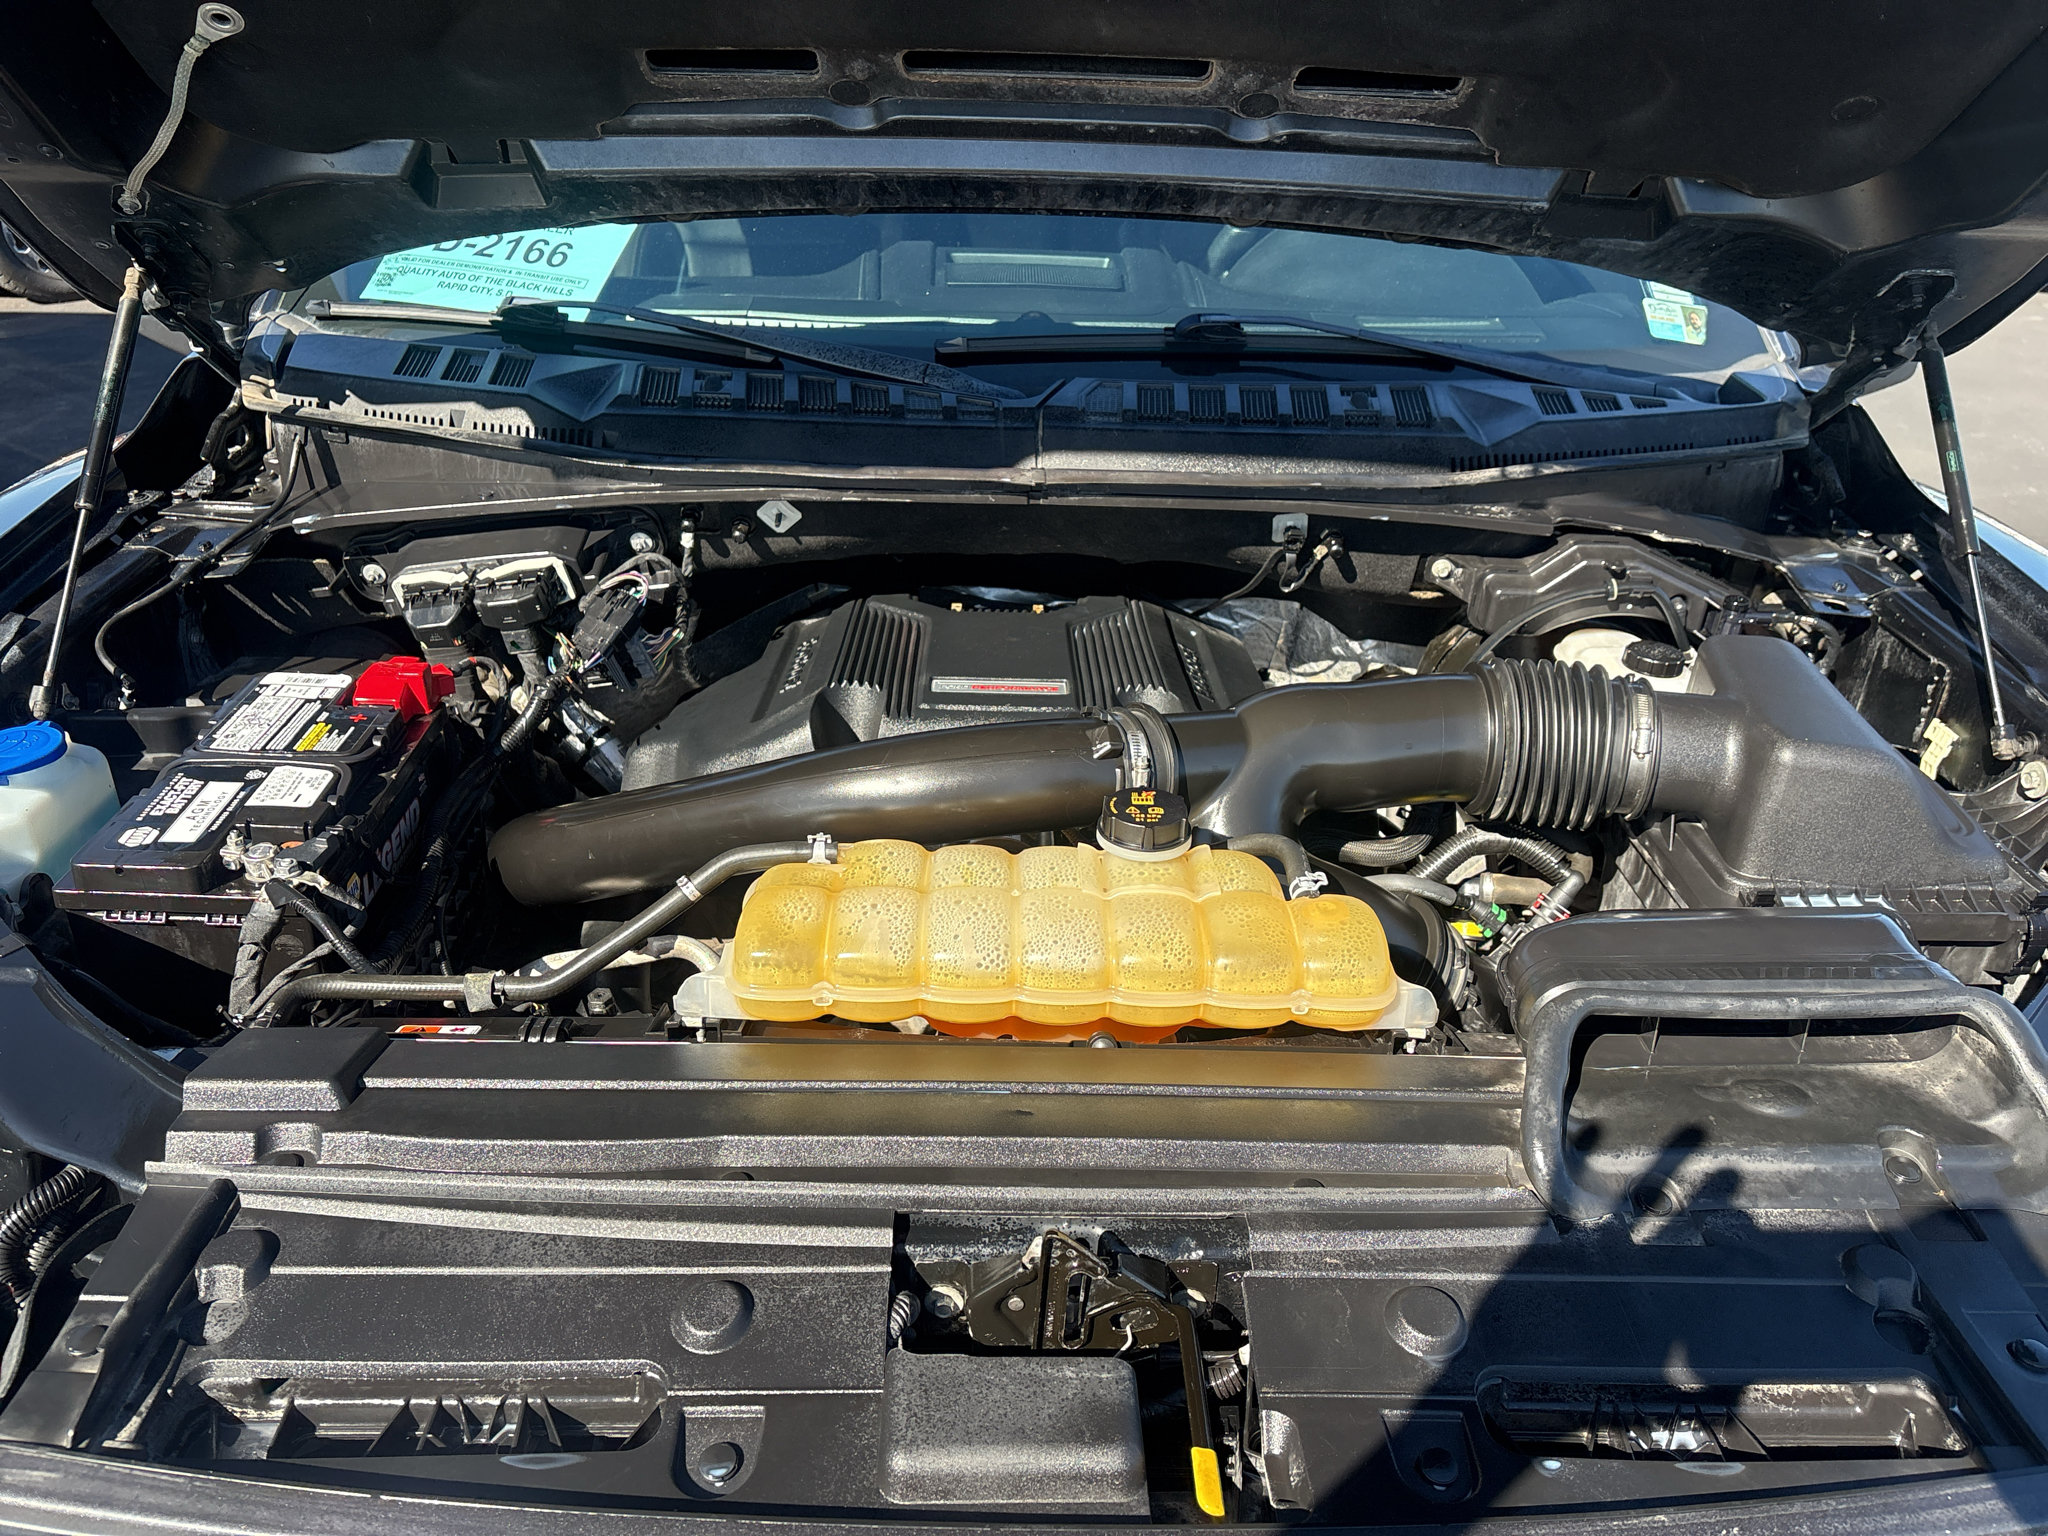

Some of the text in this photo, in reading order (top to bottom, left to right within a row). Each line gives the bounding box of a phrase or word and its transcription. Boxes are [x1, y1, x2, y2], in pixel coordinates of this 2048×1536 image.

[396, 266, 574, 297] QUALITY AUTO OF THE BLACK HILLS
[431, 259, 455, 267] DEALER
[456, 262, 507, 274] DEMONSTRATION
[437, 281, 468, 292] RAPID
[469, 285, 493, 296] CITY,
[149, 777, 193, 816] EXACT-FIT
[165, 779, 204, 814] BATTERY
[186, 799, 212, 820] AGM
[189, 791, 229, 832] TECHNOLOGY
